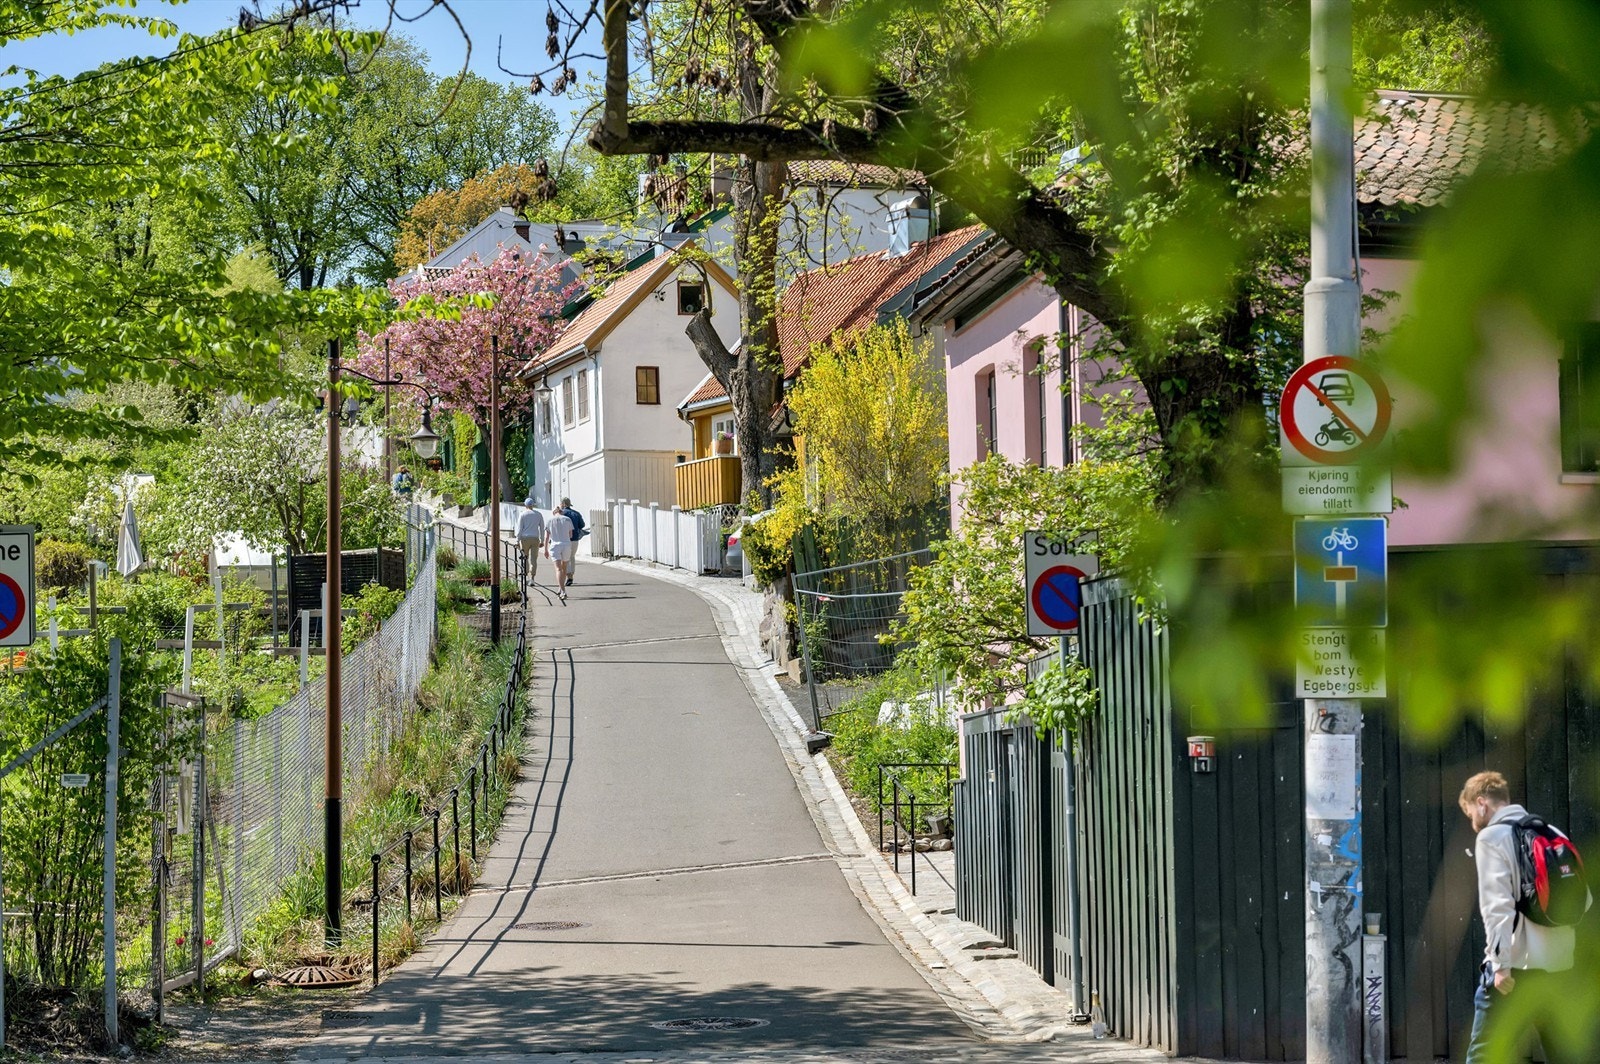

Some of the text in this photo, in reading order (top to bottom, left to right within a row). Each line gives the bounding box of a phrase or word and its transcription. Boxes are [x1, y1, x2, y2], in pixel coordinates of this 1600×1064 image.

[1309, 470, 1349, 482] Kjøring
[1298, 484, 1375, 494] eiendomme
[1323, 499, 1352, 508] tillatt
[1302, 634, 1346, 647] Stengt
[1314, 650, 1341, 660] bom
[1304, 680, 1378, 695] Egebegsgt.
